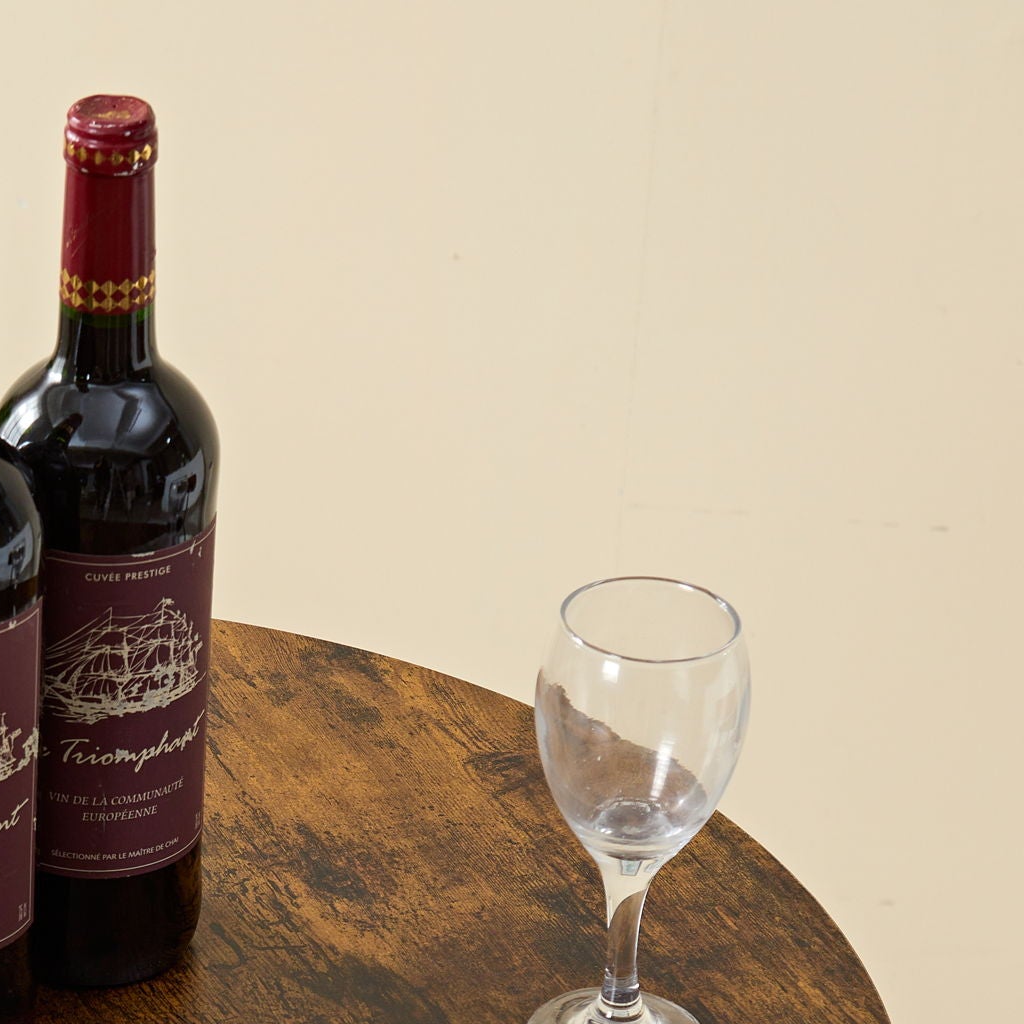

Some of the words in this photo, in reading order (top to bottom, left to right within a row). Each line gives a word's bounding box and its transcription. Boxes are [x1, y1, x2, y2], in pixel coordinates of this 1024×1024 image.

[85, 572, 121, 582] CUVÉE
[125, 565, 172, 580] PRESTIGE
[49, 791, 70, 804] VIN
[73, 795, 89, 806] DE
[111, 775, 184, 806] COMMUNAUTÉ
[82, 804, 158, 822] EUROPÉENNE
[118, 852, 127, 860] LE
[155, 844, 165, 853] DE
